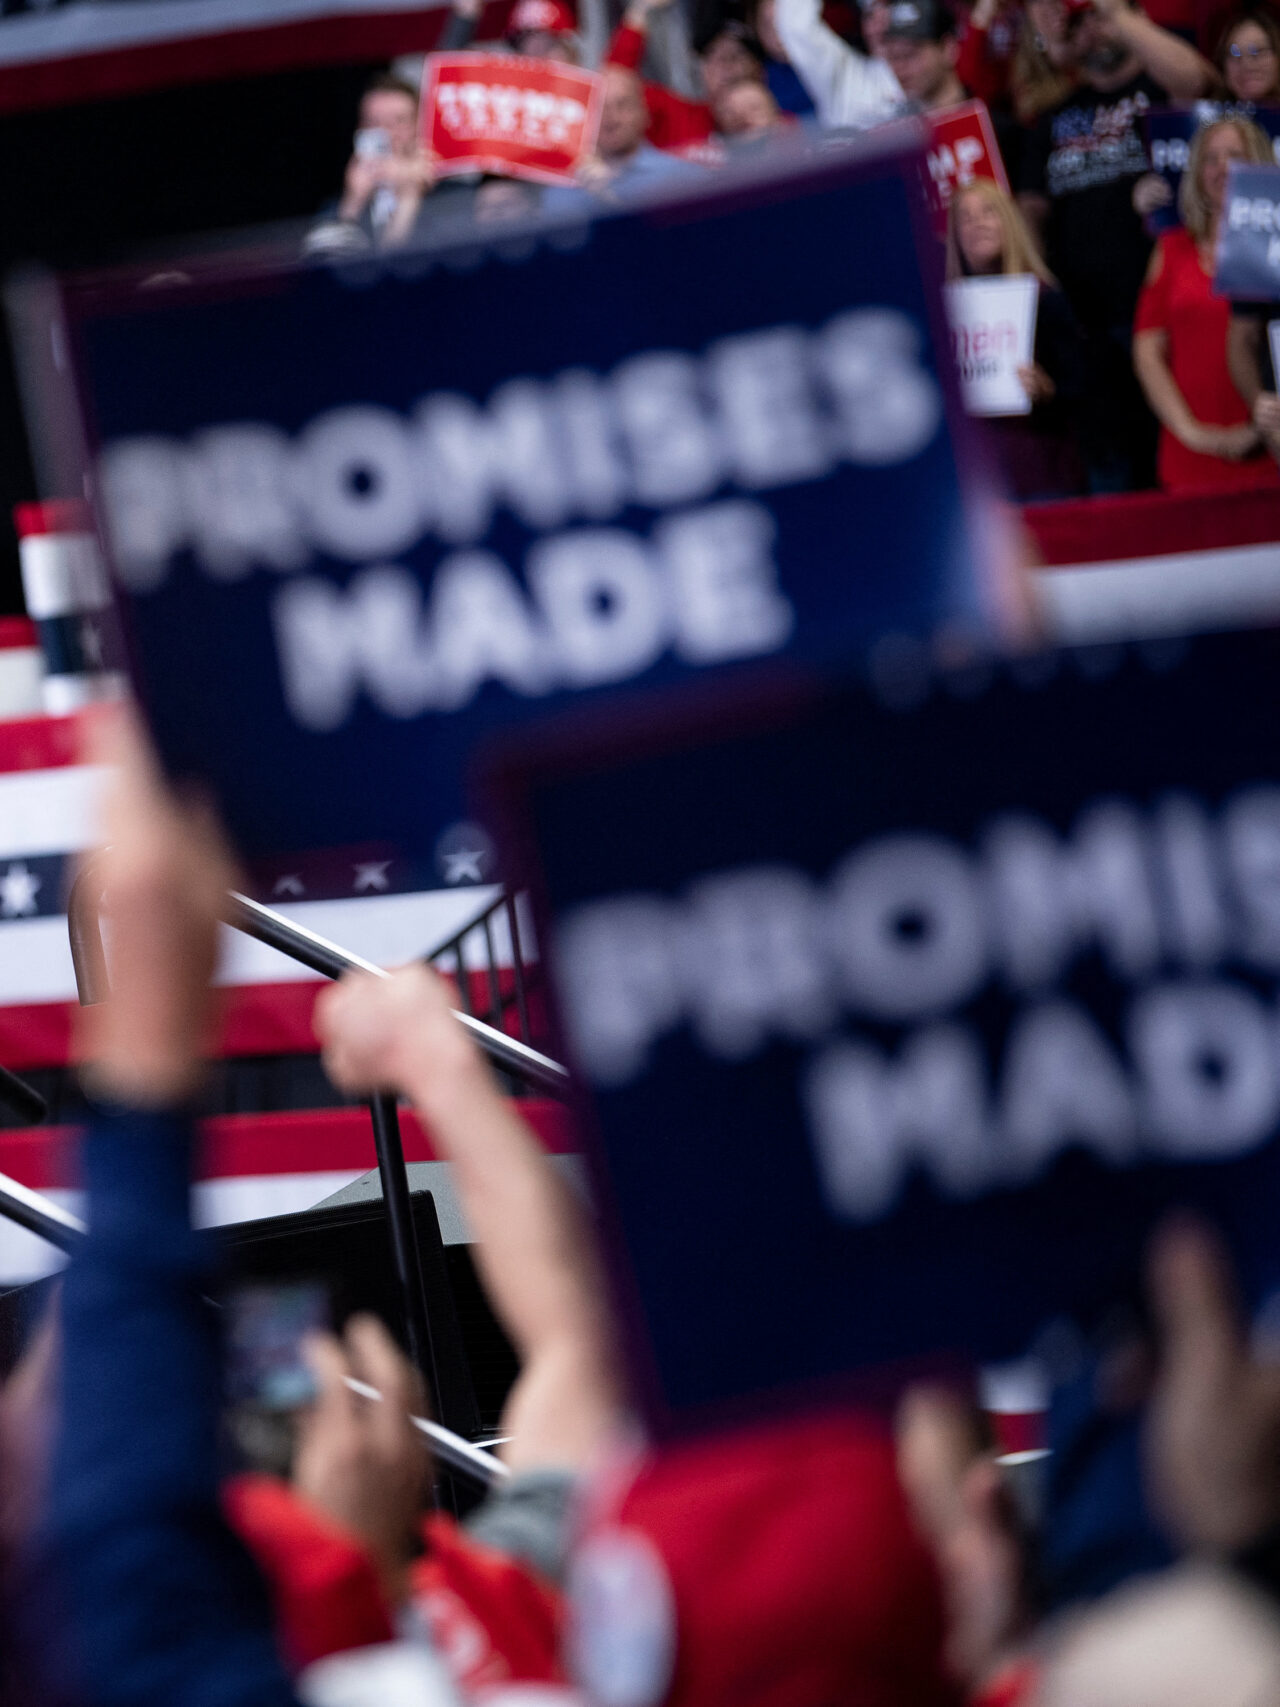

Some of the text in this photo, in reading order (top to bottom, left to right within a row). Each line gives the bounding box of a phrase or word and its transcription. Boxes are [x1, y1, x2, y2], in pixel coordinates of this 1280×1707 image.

[103, 308, 939, 591] PROMISES
[271, 500, 795, 732] MADE
[807, 986, 1280, 1225] MAD
